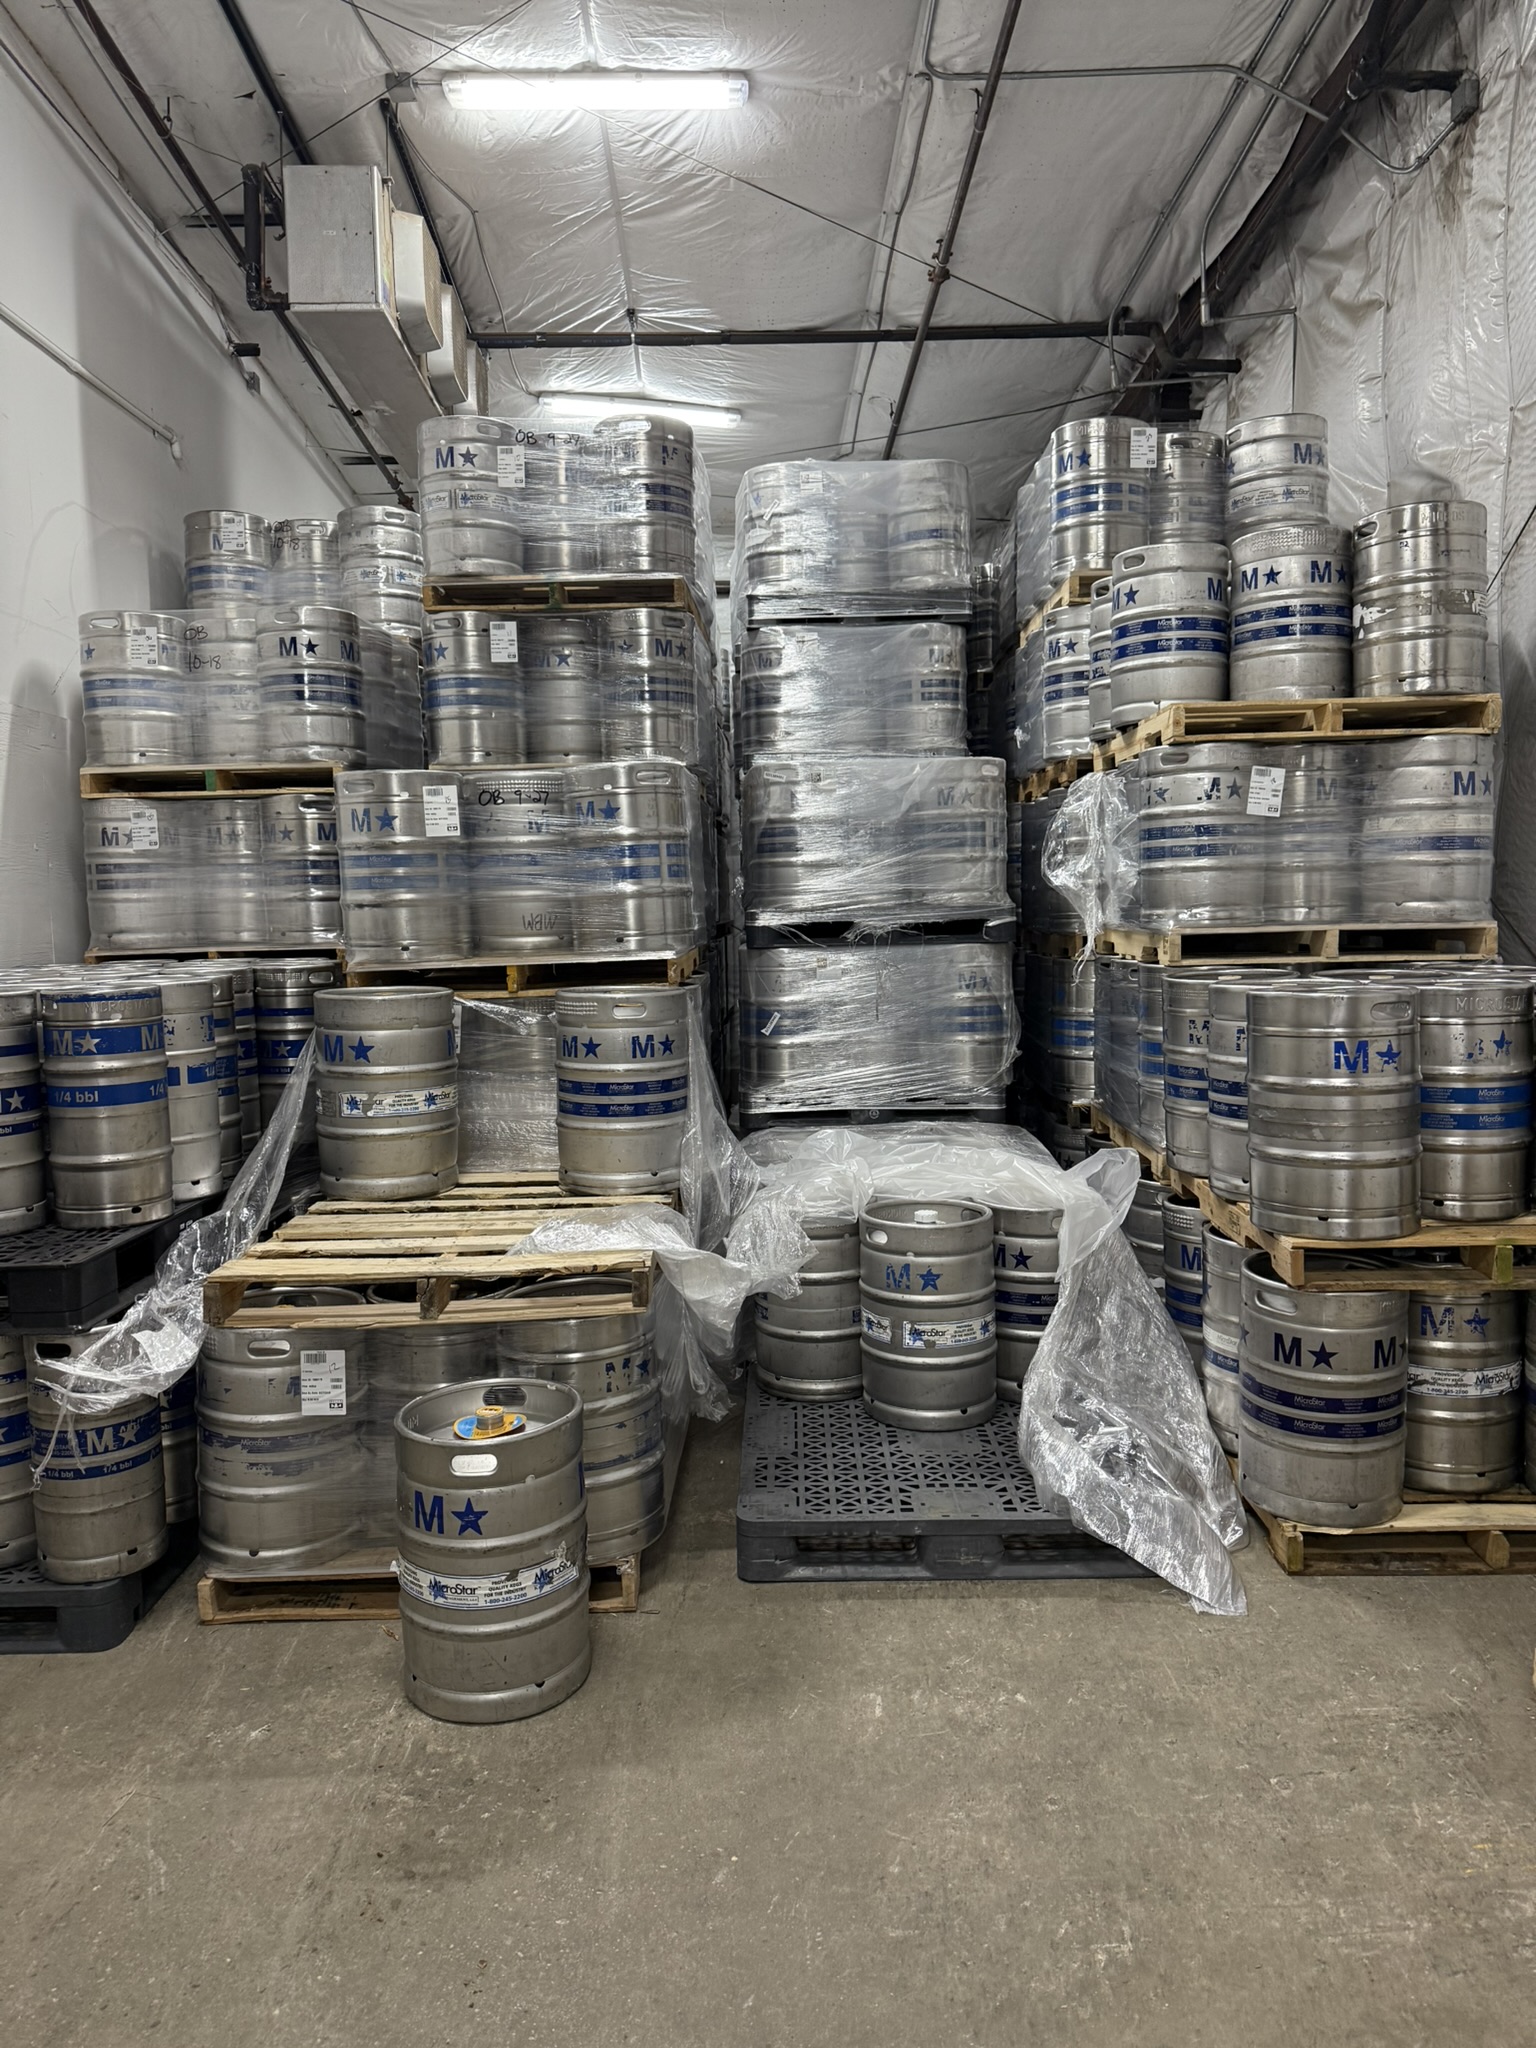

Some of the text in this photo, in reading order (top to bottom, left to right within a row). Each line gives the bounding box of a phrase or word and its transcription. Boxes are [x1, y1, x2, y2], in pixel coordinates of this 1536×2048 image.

[516, 430, 537, 445] OB
[436, 446, 455, 469] M
[1058, 452, 1073, 474] M
[1294, 443, 1312, 465] M
[273, 519, 292, 532] OB
[272, 537, 300, 551] 10-18
[1241, 567, 1258, 593] M
[1310, 560, 1332, 584] M
[1207, 577, 1222, 601] M
[184, 625, 208, 640] OB
[279, 636, 297, 657] M
[340, 640, 354, 661] M
[655, 638, 672, 657] M
[1048, 637, 1061, 659] M
[186, 651, 222, 673] 10-18
[1454, 771, 1476, 796] M
[478, 789, 505, 806] OB
[938, 788, 955, 806] M
[351, 808, 372, 833] M
[576, 801, 596, 825] M
[101, 827, 119, 847] M
[317, 823, 336, 841] M
[958, 972, 977, 991] M
[53, 1031, 73, 1056] M
[141, 1025, 160, 1051] M
[324, 1035, 343, 1063] M
[563, 1035, 578, 1059] M
[631, 1034, 655, 1059] M
[1334, 1040, 1370, 1074] M
[53, 1089, 99, 1104] 1/4 bbl
[149, 1082, 164, 1097] 1/4
[1181, 1244, 1202, 1271] M
[885, 1263, 911, 1290] M
[1420, 1306, 1455, 1338] M
[1274, 1332, 1303, 1368] M
[1373, 1335, 1397, 1370] M
[1294, 1394, 1326, 1407] MicroStar
[1293, 1419, 1326, 1431] MicroStar
[87, 1426, 115, 1455] M
[240, 1438, 271, 1447] MicroStar
[48, 1468, 75, 1480] 1/4 bbl
[103, 1459, 133, 1474] 1/4 bbl
[414, 1490, 444, 1535] M
[484, 1592, 528, 1605] 1-800-245-2200
[488, 1583, 509, 1592] QUALITY
[504, 1585, 527, 1595] INDUSTRY
